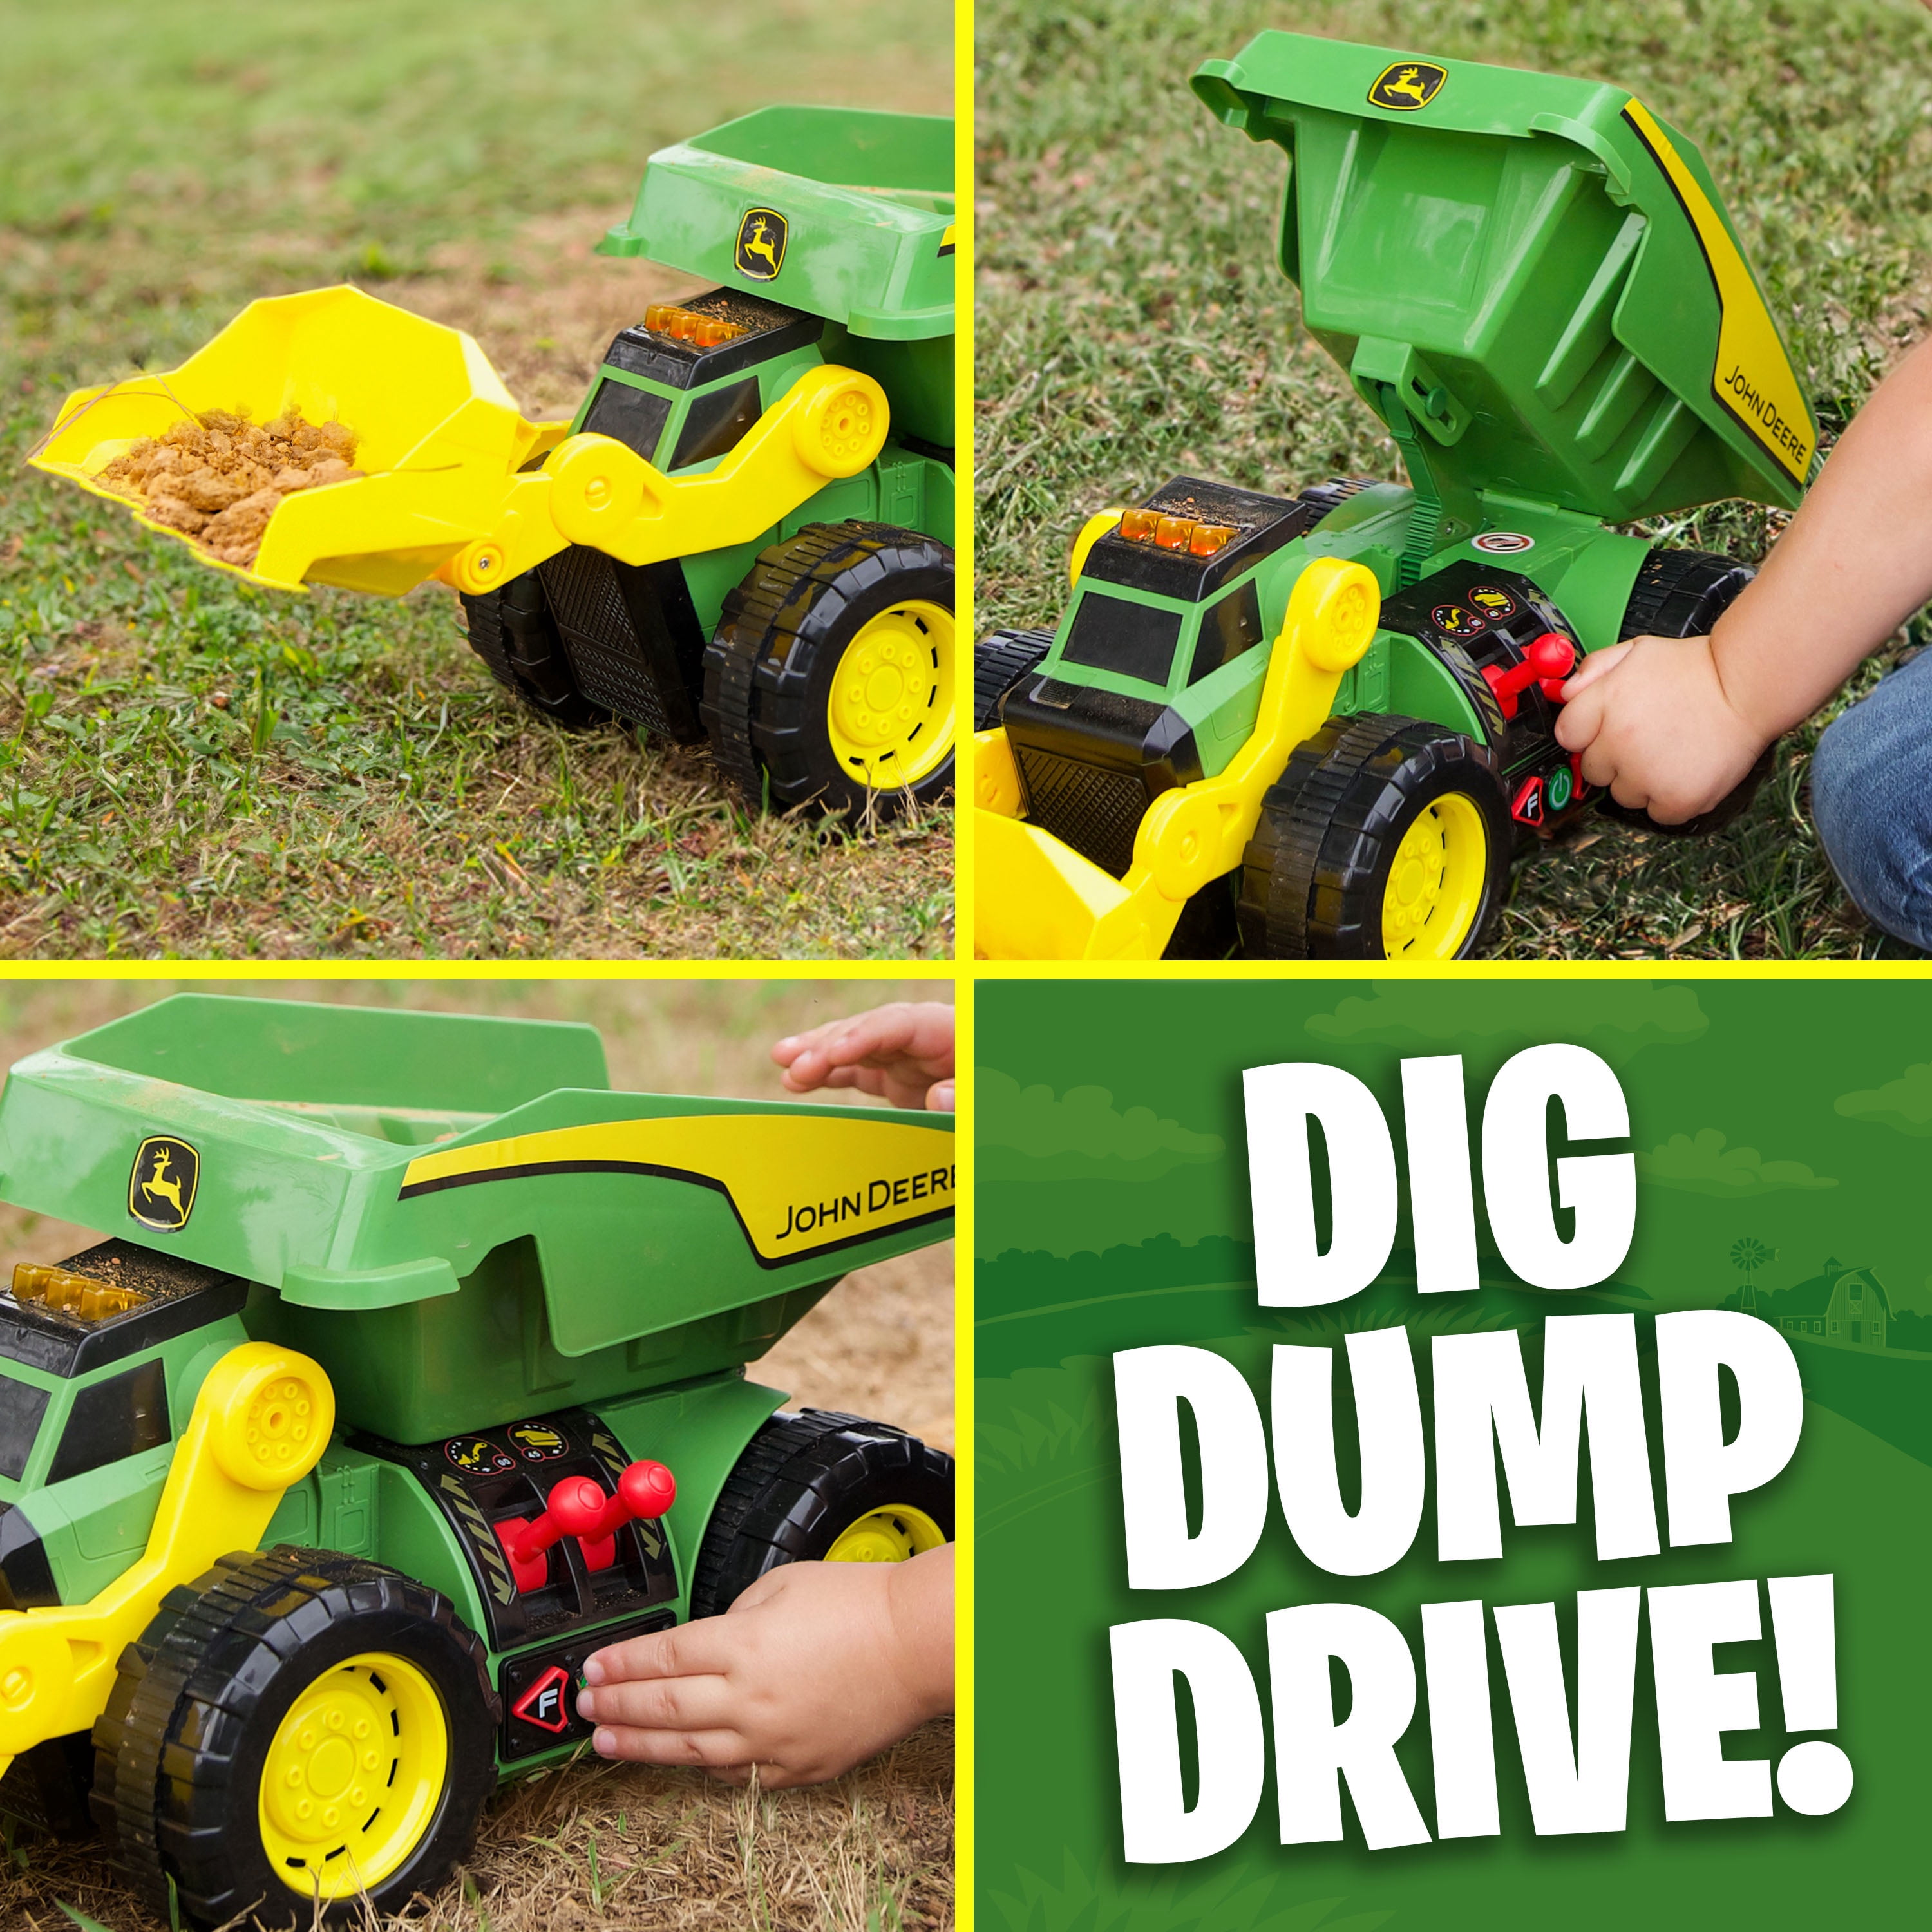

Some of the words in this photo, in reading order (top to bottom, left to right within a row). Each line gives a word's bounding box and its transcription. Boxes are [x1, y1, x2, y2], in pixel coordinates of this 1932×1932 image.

[1724, 365, 1765, 417] JOHN
[1761, 402, 1807, 465] DEERE
[1528, 793, 1538, 817] F
[775, 1191, 861, 1240] JOHN
[868, 1164, 955, 1213] DEER
[539, 1688, 558, 1718] F
